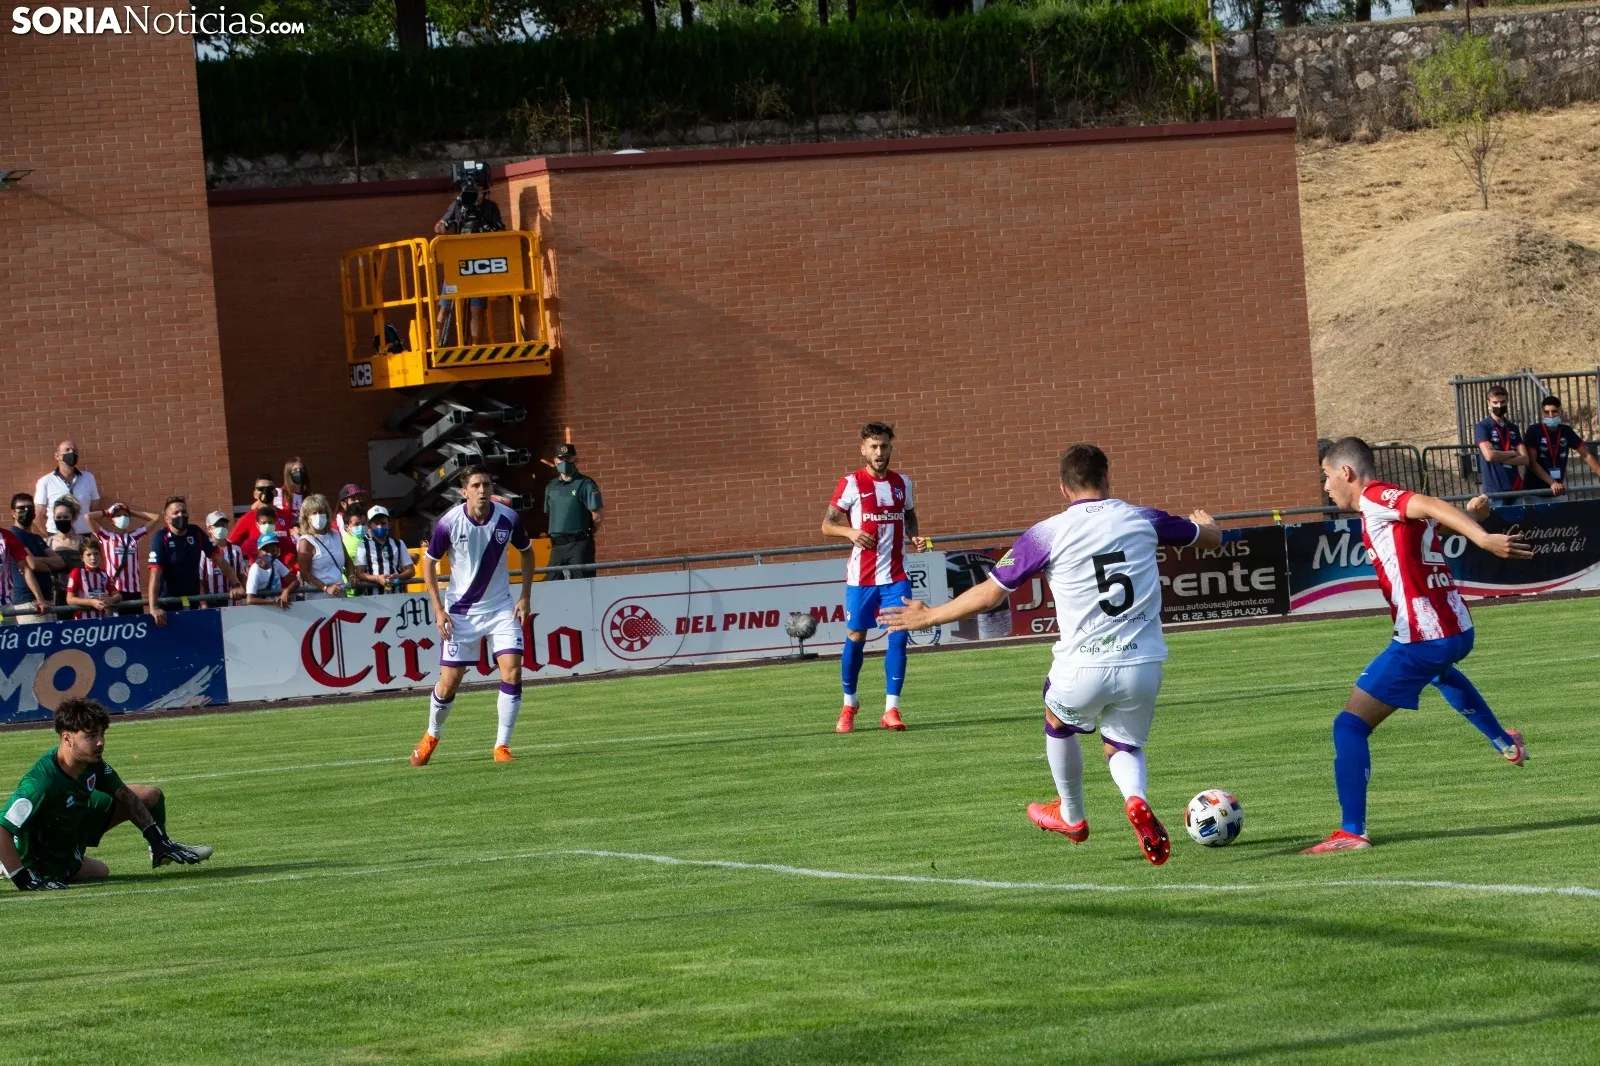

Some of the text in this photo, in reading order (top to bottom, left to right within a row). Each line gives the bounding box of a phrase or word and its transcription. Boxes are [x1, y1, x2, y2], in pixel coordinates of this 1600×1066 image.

[460, 258, 508, 275] JCB
[350, 364, 373, 387] JCB
[1569, 537, 1587, 552] ti!
[1091, 550, 1135, 617] 5
[675, 614, 717, 635] DEL
[722, 609, 780, 631] PINO
[1221, 609, 1233, 618] 55
[1234, 606, 1268, 616] PLAZAS
[1030, 616, 1060, 633] 67
[0, 621, 148, 650] ía de seguros
